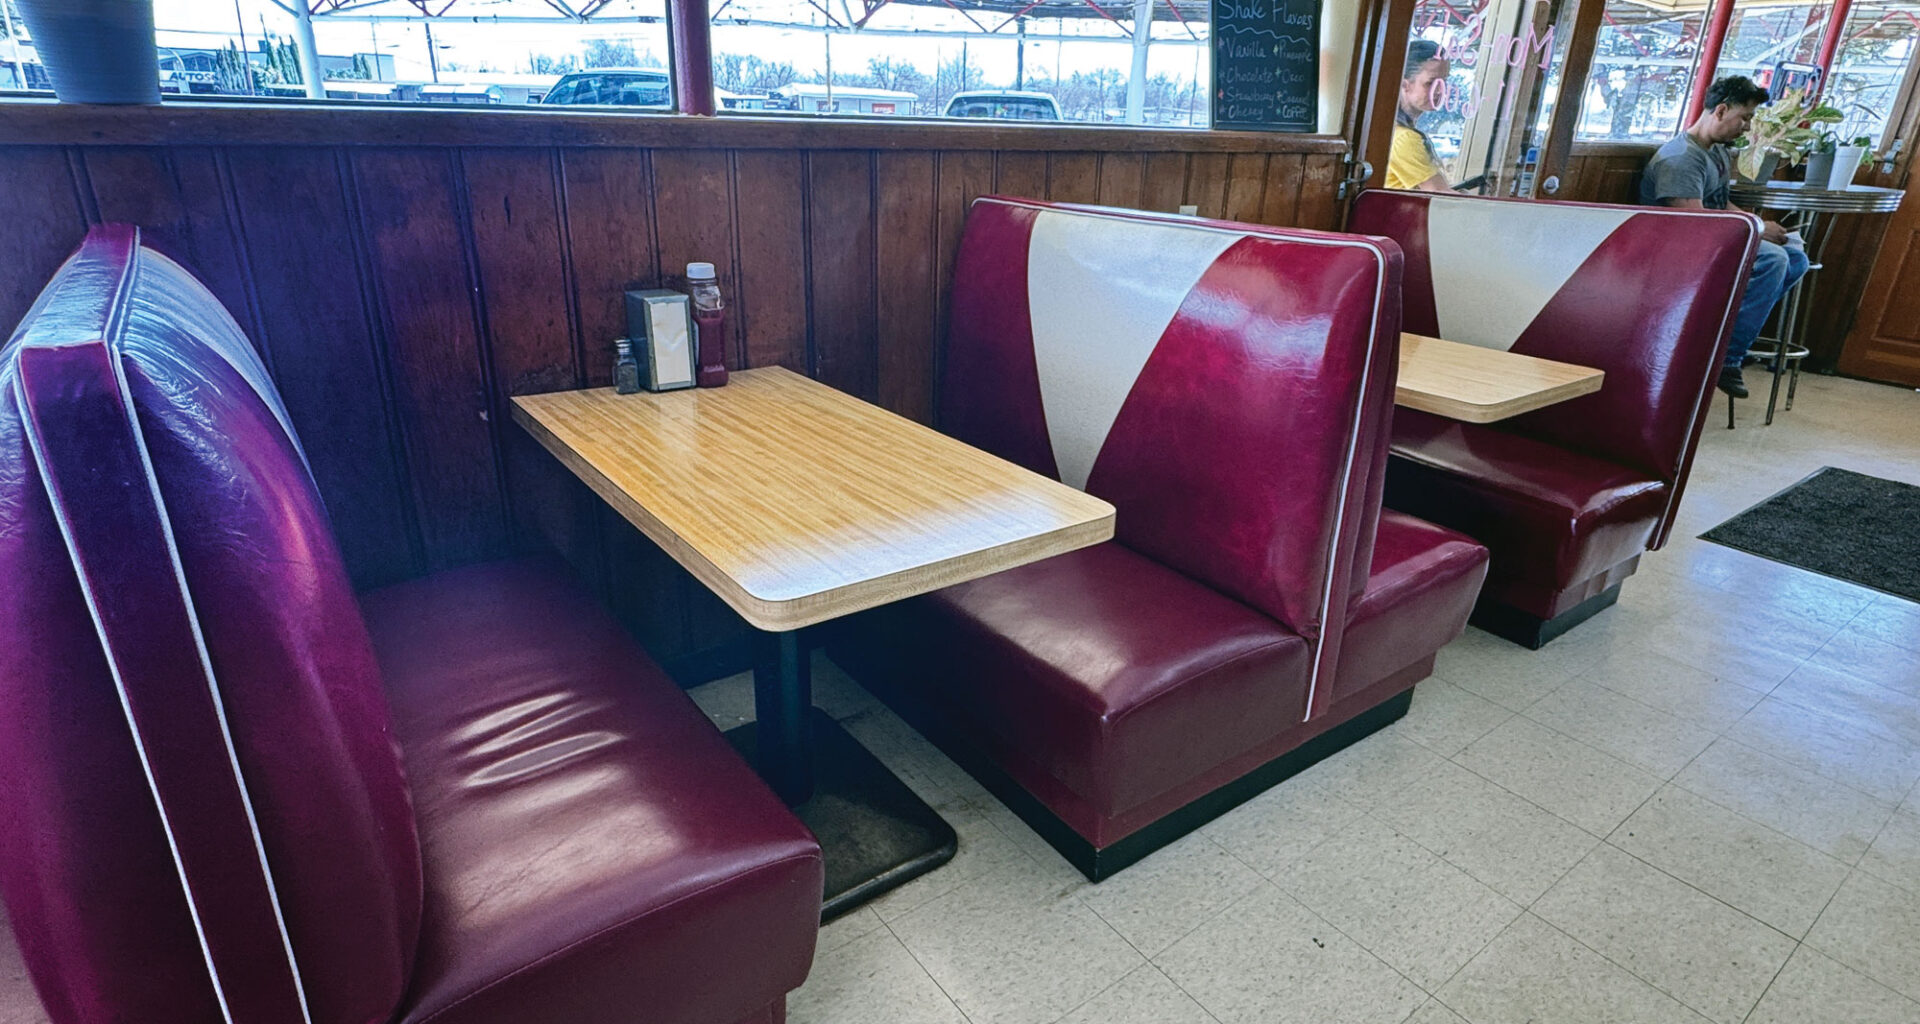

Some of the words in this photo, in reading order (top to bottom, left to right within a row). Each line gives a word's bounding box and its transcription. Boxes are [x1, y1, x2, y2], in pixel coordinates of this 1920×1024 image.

[1219, 0, 1266, 20] Shake
[1226, 37, 1266, 58] Vanilla
[1227, 66, 1273, 83] Chocolate
[1227, 87, 1274, 108] Strawberry
[1228, 105, 1263, 120] Cherry
